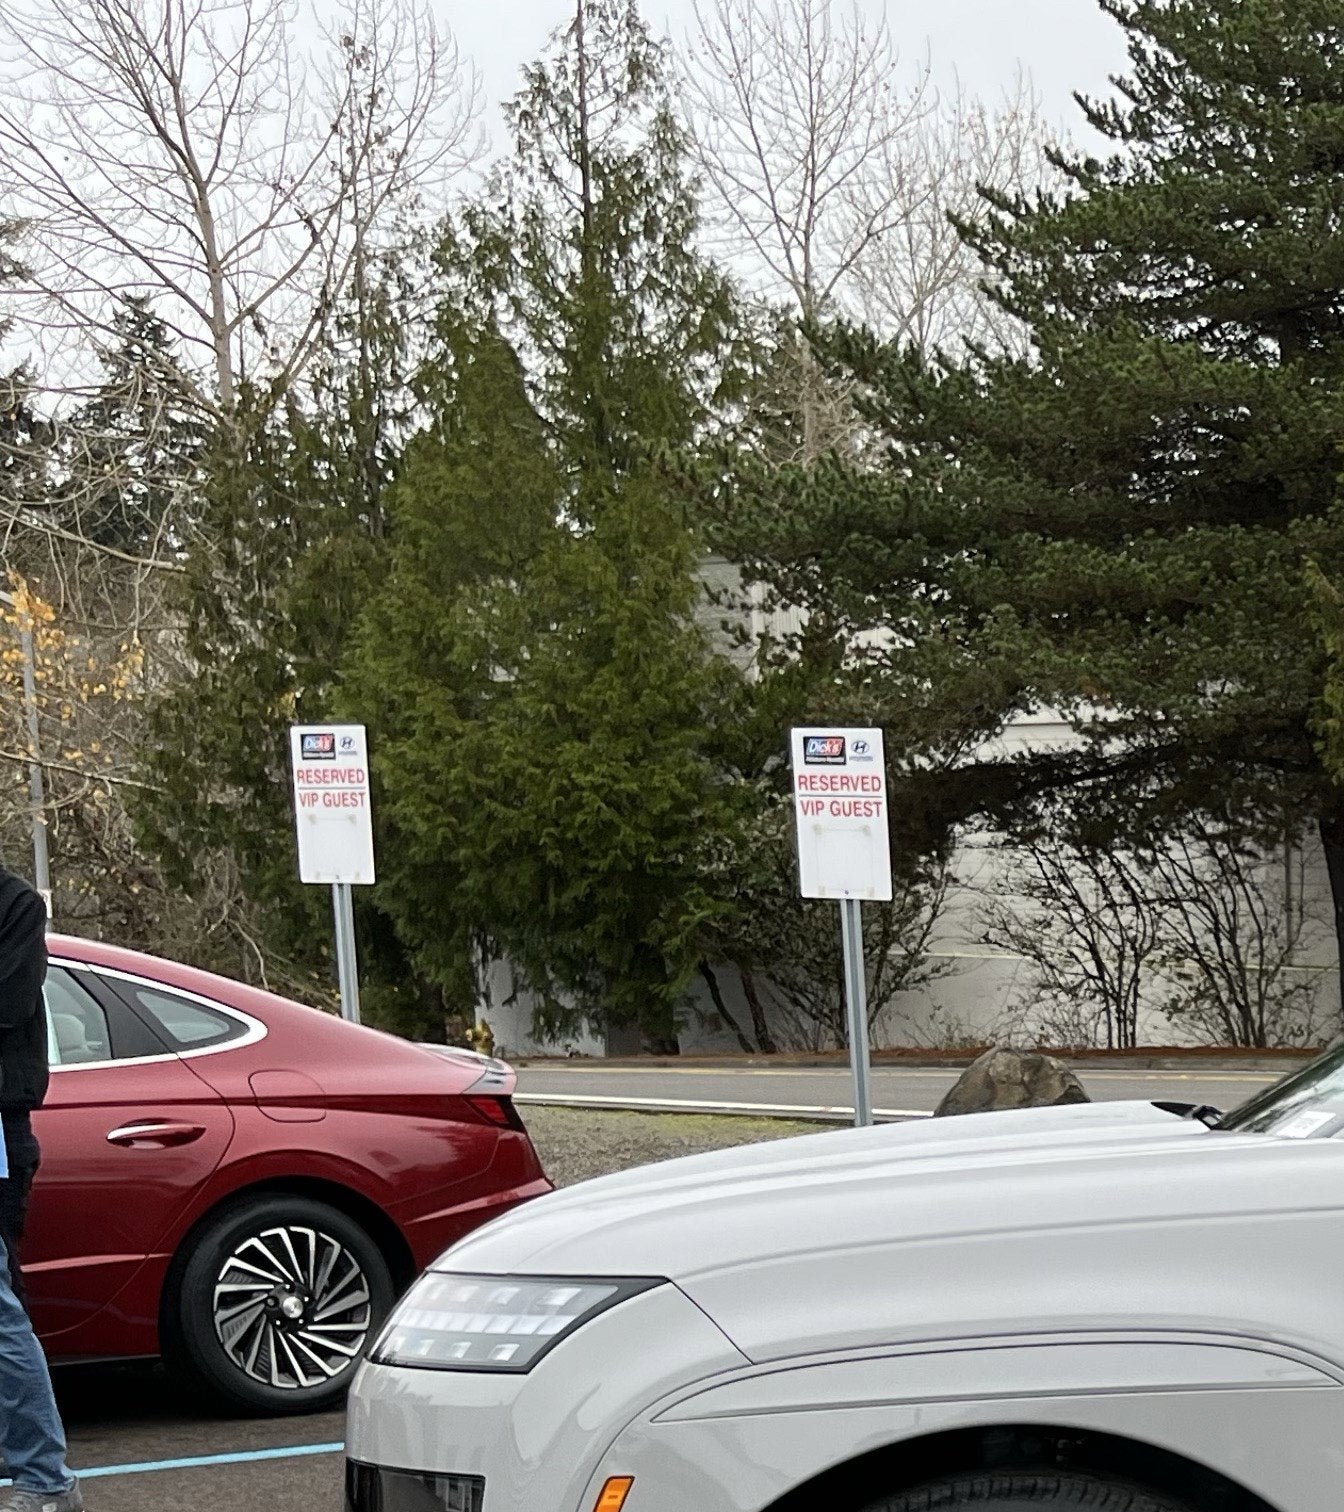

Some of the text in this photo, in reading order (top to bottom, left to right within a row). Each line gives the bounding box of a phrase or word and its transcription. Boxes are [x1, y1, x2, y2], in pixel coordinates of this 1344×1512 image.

[297, 768, 365, 785] RESERVED
[798, 775, 882, 793] RESERVED
[299, 792, 366, 808] VIP GUEST
[800, 800, 882, 818] VIP GUEST
